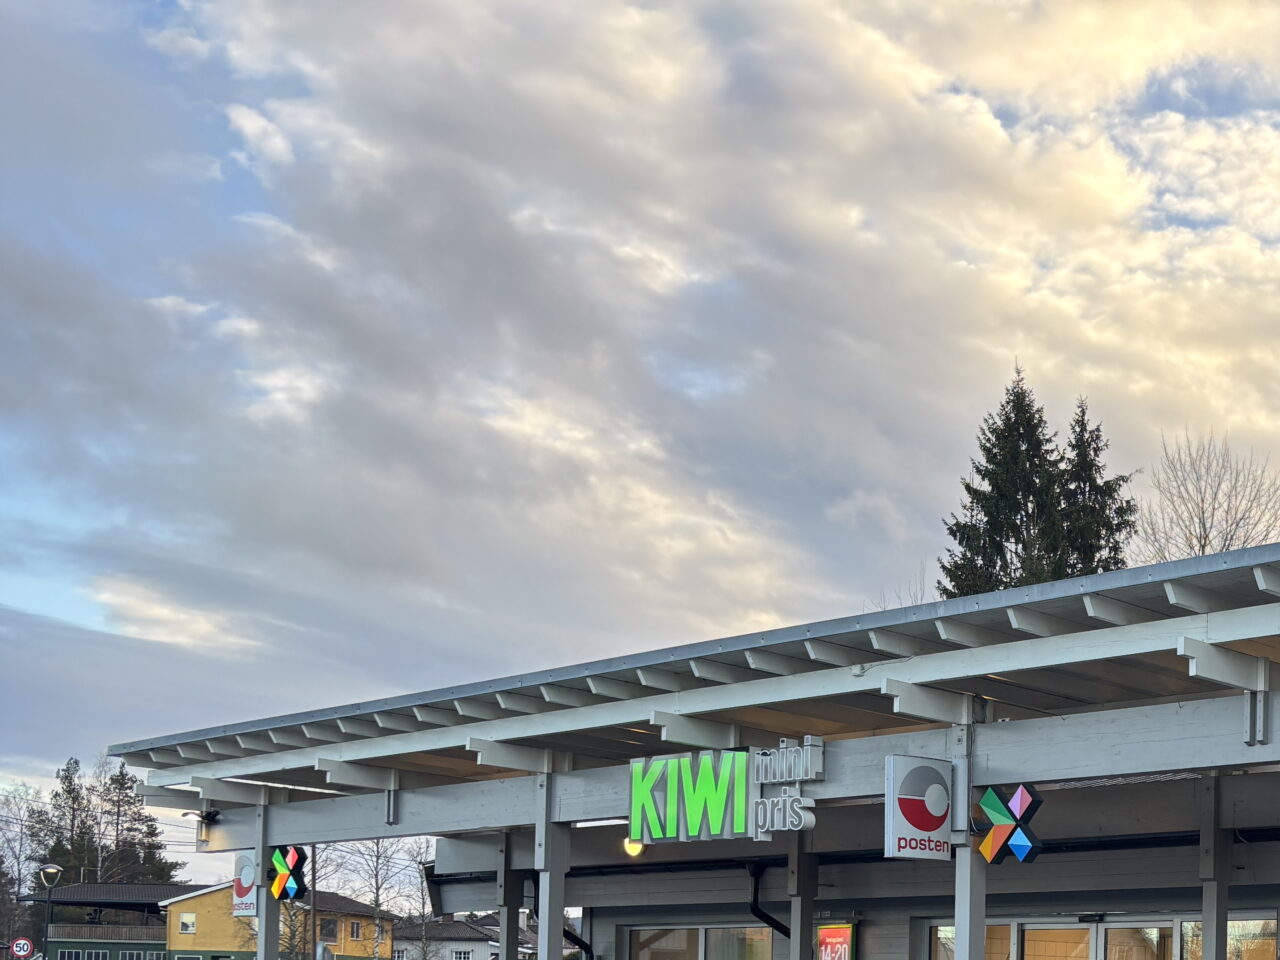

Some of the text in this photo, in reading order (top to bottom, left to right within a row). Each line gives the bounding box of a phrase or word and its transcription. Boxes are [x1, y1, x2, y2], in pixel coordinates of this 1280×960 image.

[754, 736, 812, 784] mini
[630, 751, 748, 841] KIWI
[753, 787, 806, 841] pris
[897, 836, 950, 853] posten
[15, 943, 29, 952] 50
